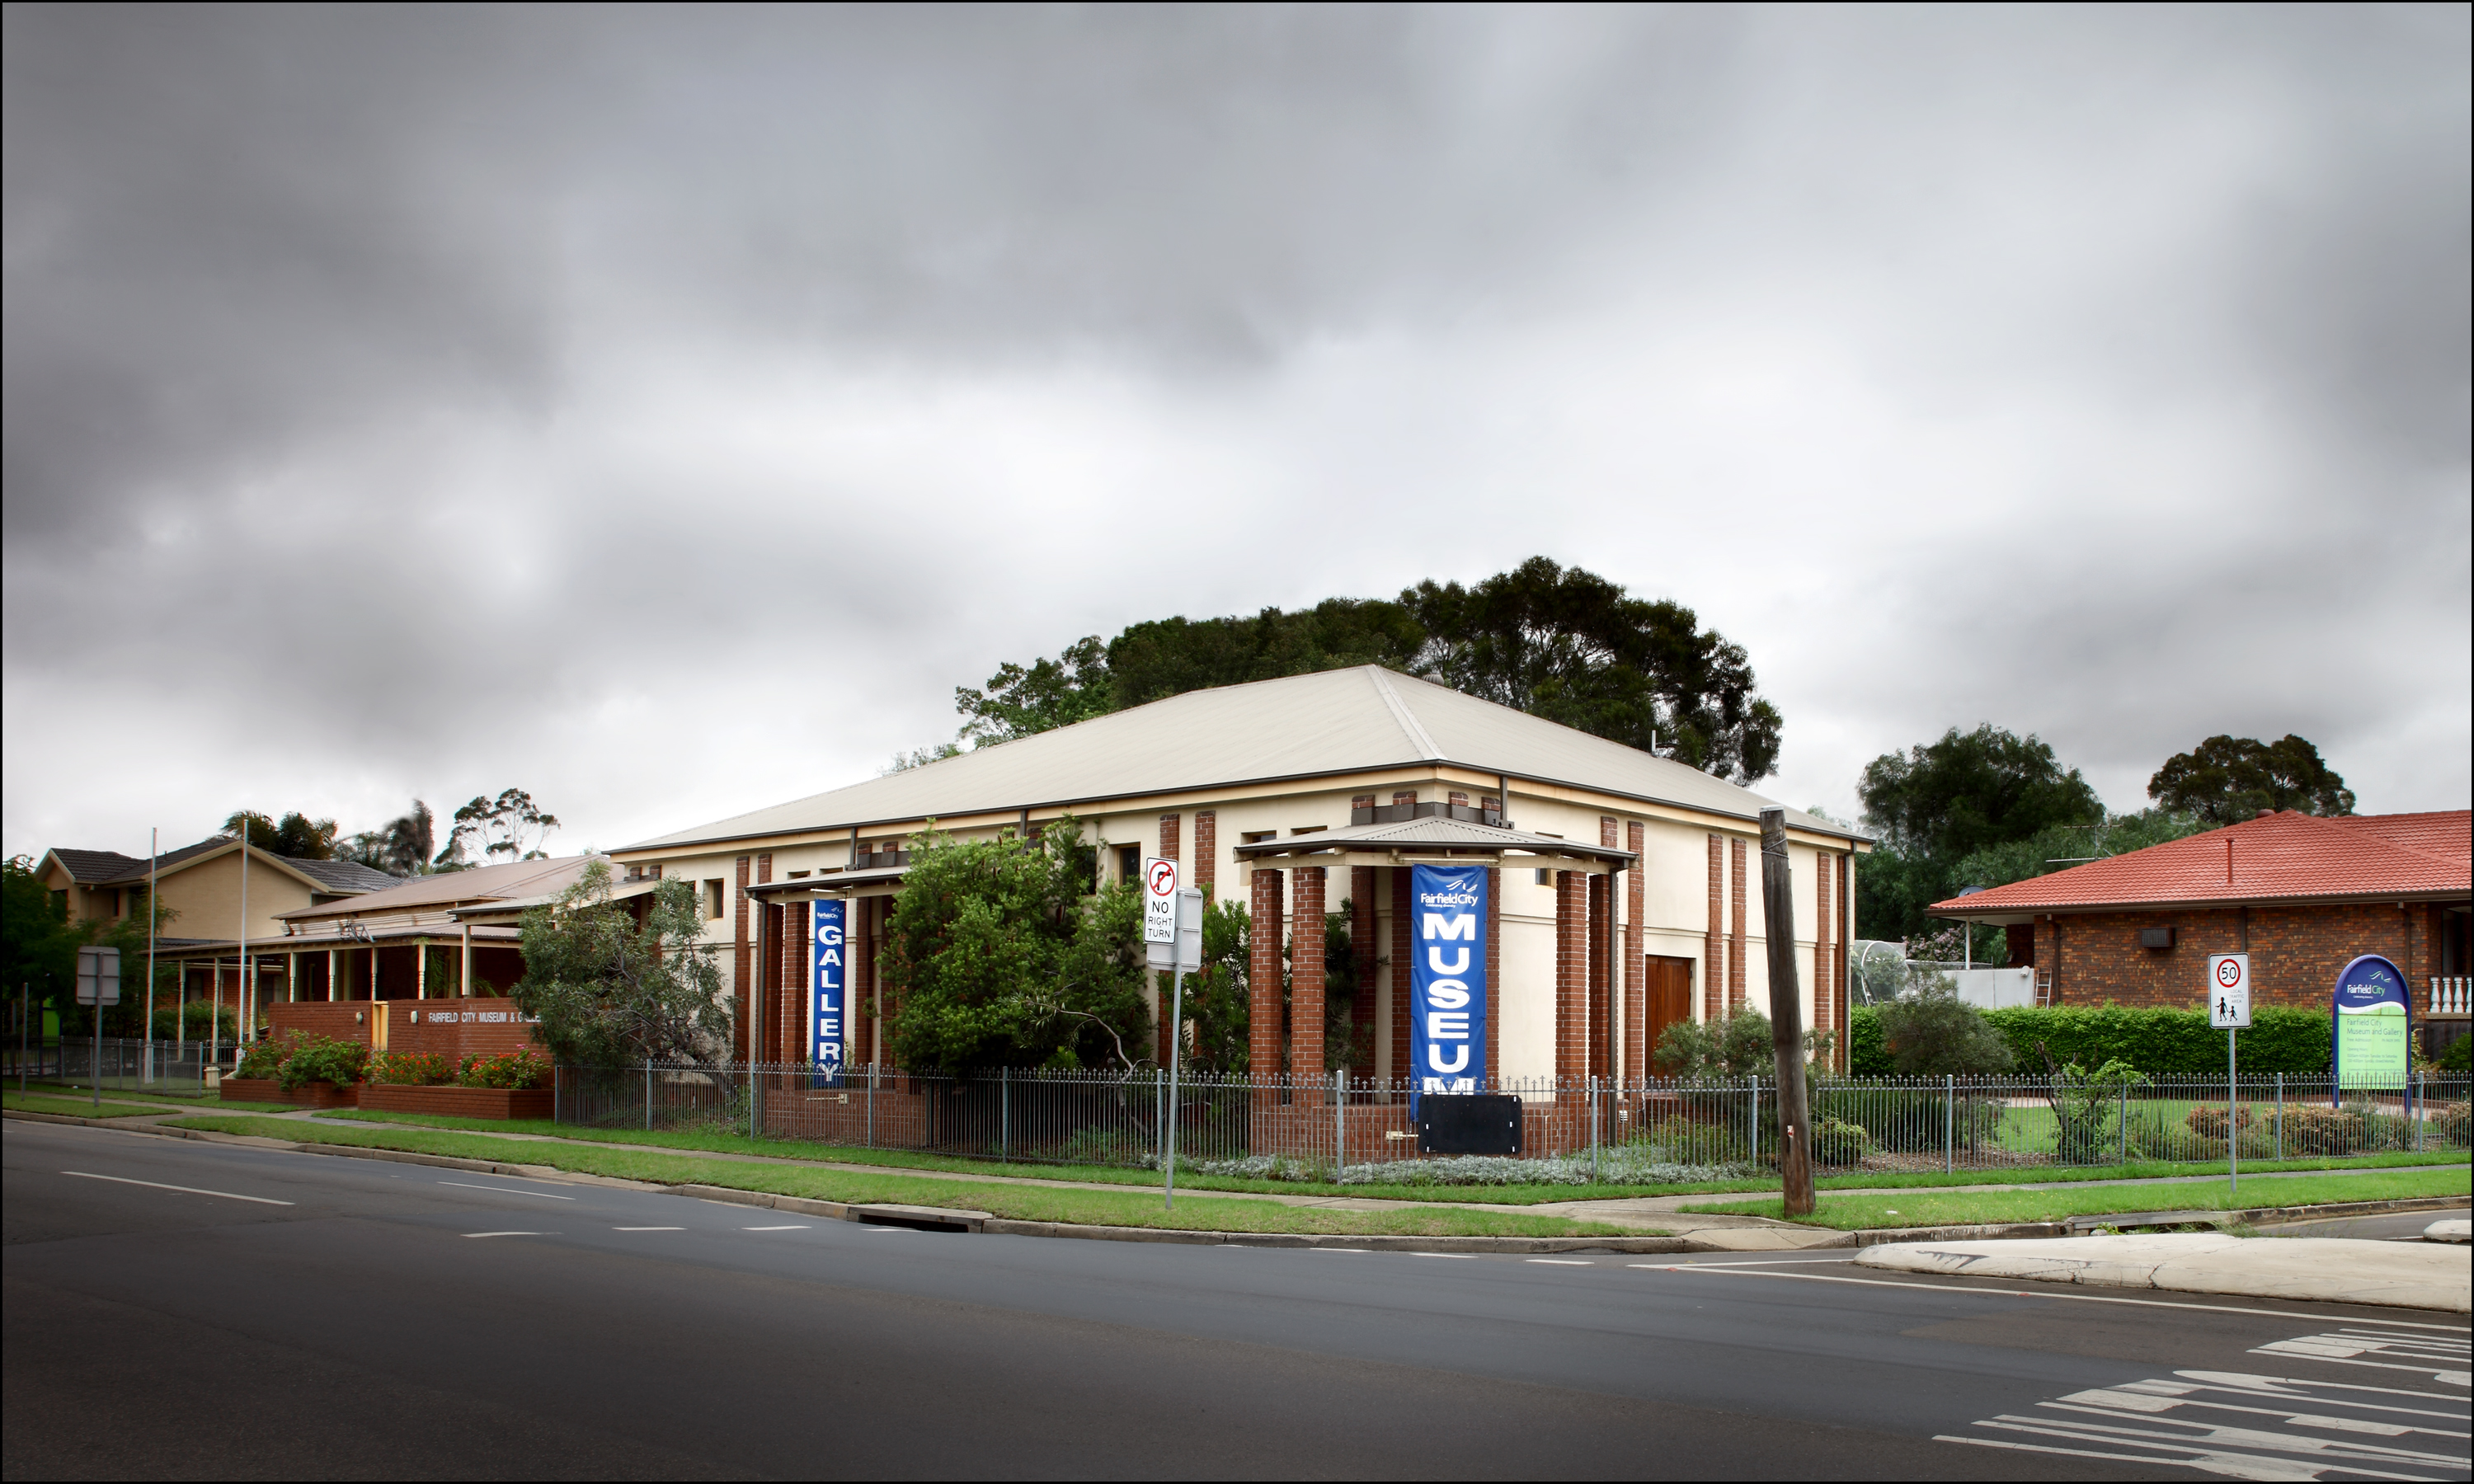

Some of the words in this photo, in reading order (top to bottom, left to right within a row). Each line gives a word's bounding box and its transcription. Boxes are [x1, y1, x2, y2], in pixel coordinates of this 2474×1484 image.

[1152, 900, 1169, 913] NO
[1148, 916, 1173, 926] RIGHT
[1148, 928, 1170, 938] TURN
[2222, 967, 2236, 979] 50
[817, 925, 842, 1082] GALLERY
[1423, 913, 1475, 1095] MUSEUM
[429, 1012, 458, 1022] FAIRFIELD
[462, 1012, 476, 1022] CITY
[479, 1012, 506, 1022] MUSEUM
[510, 1012, 515, 1022] &
[2347, 1018, 2369, 1026] Fairfield
[2370, 1019, 2382, 1027] City
[2383, 1028, 2402, 1037] Gallery
